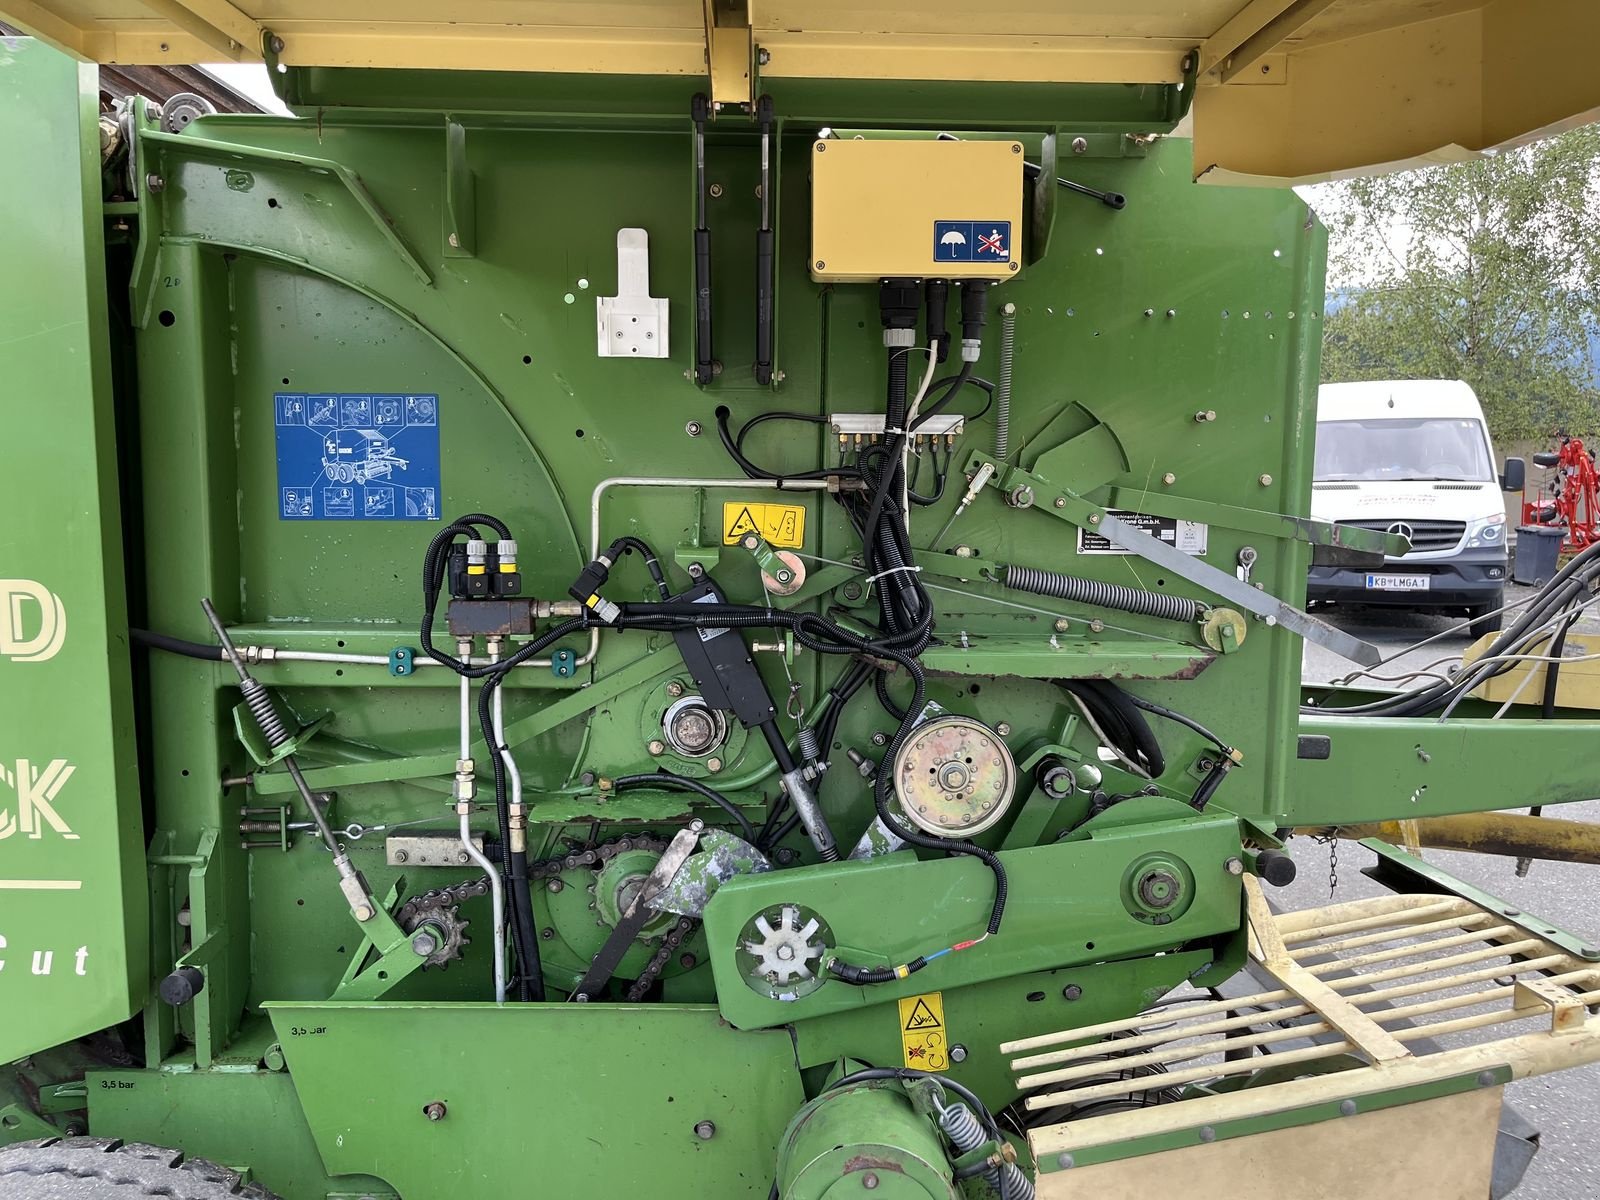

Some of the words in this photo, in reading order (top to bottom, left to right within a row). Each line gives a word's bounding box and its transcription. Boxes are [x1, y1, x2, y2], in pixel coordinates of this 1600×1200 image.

[1375, 577, 1387, 586] KB
[291, 1027, 307, 1037] 3,5
[101, 1080, 116, 1089] 3,5
[118, 1080, 135, 1089] bar
